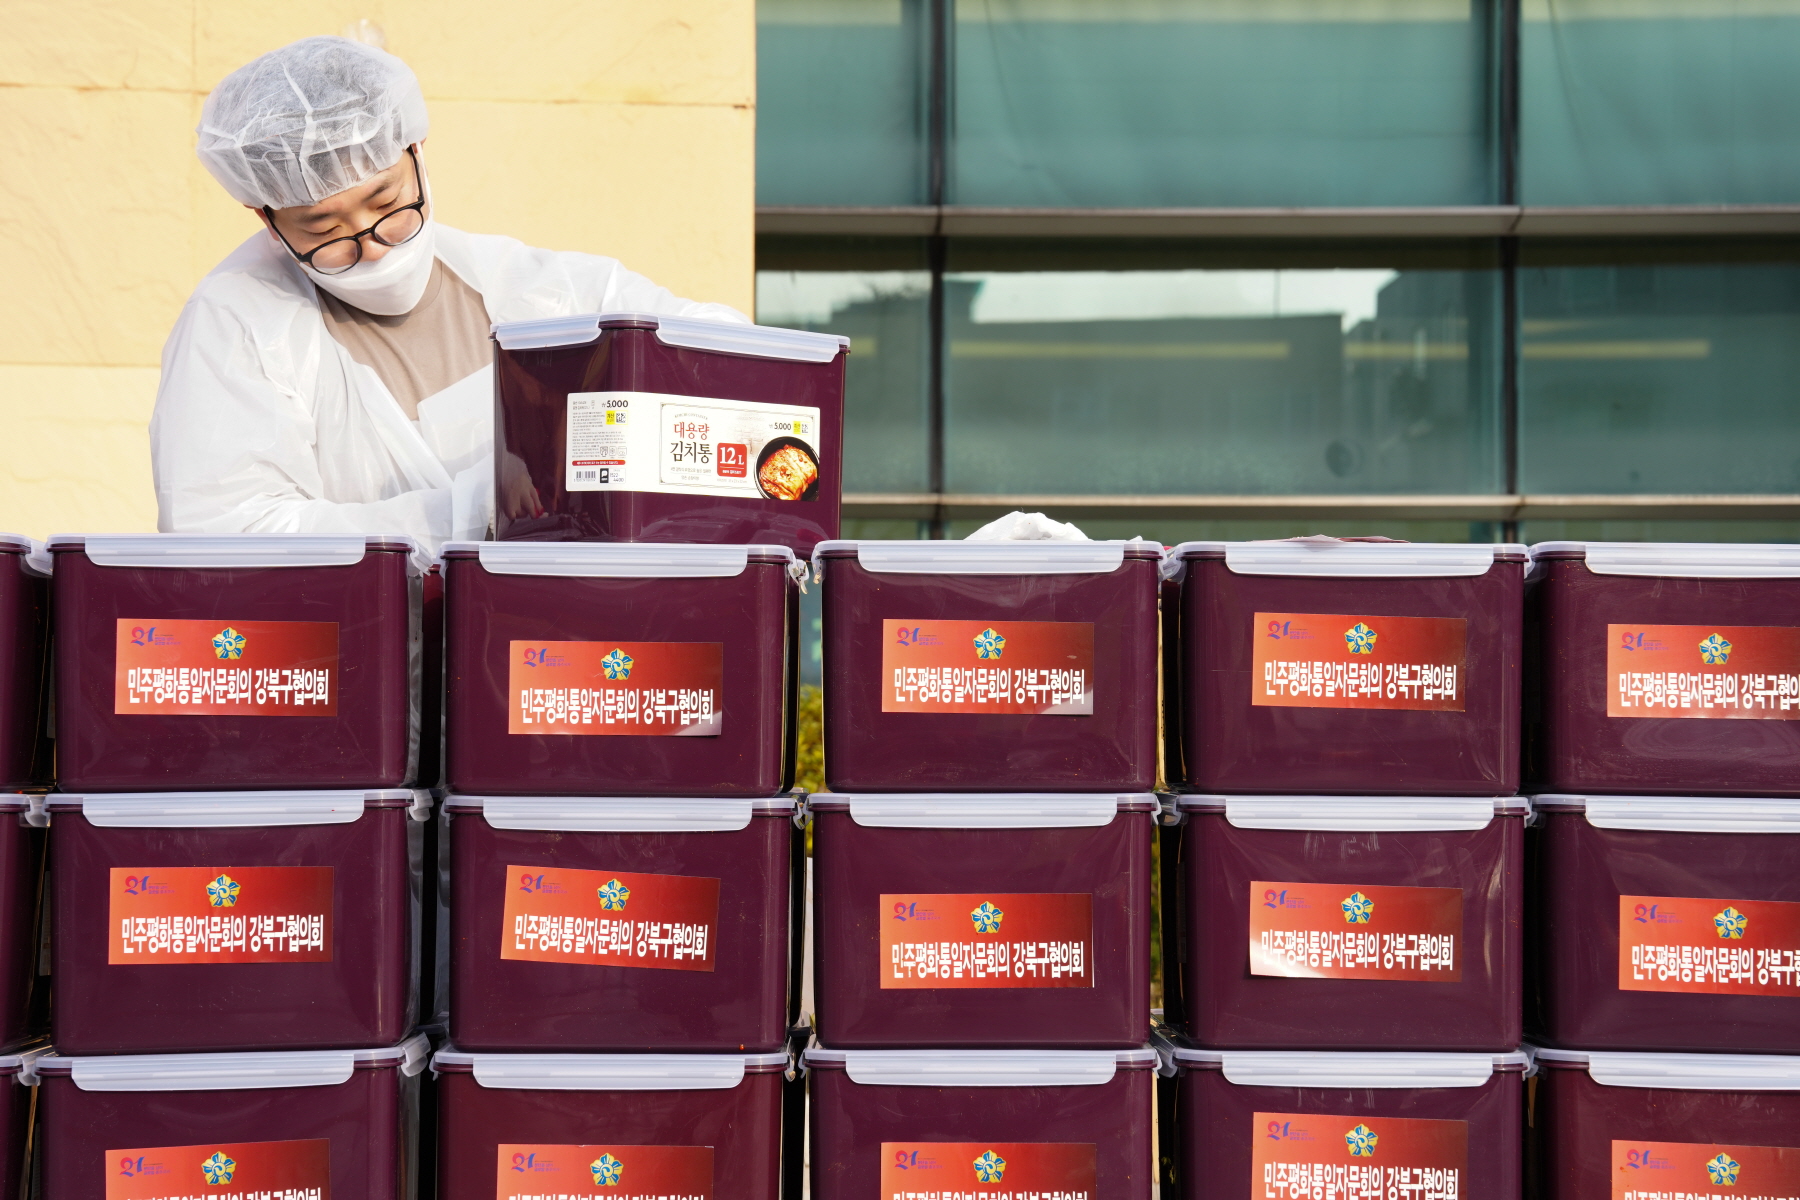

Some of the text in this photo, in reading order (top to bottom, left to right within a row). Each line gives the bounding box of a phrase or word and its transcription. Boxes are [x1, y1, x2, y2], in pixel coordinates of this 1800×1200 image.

[607, 400, 628, 408] 5,000
[674, 421, 710, 440] 대용량
[774, 422, 791, 431] 5,000
[670, 441, 712, 464] 김치통
[132, 627, 156, 646] 21
[898, 628, 920, 646] 21
[1269, 621, 1291, 640] 21
[1623, 633, 1645, 651] 21
[525, 649, 547, 667] 21
[127, 666, 329, 706] 민주평화통일자문회의 강북구협의회
[894, 666, 1085, 706] 민주평화통일자문회의 강북구협의회
[1264, 659, 1457, 701] 민주평화통일자문회의 강북구협의회
[1619, 671, 1739, 709] 민주평화통일자문회의
[521, 687, 714, 726] 민주평화통일자문회의 강북구협의회
[126, 876, 150, 895] 21
[521, 875, 545, 893] 21
[1265, 890, 1288, 908] 21
[894, 903, 917, 921] 21
[1635, 905, 1659, 923] 21
[121, 914, 324, 954] 민주평화통일자문회의 강북구협의회
[514, 913, 708, 961] 민주평화통일자문회의 강북구협의회
[1260, 929, 1454, 971] 민주평화통일자문회의 강북구협의회
[891, 941, 1084, 979] 민주평화통일자문회의 강북구협의회
[1631, 943, 1754, 985] 민주평화통일자문회의
[1268, 1122, 1291, 1141] 21
[120, 1157, 145, 1177] 21
[512, 1153, 537, 1172] 21
[896, 1151, 919, 1170] 21
[1628, 1150, 1651, 1169] 21
[1264, 1161, 1459, 1200] 민주평화통일자문회의 강북구협의회
